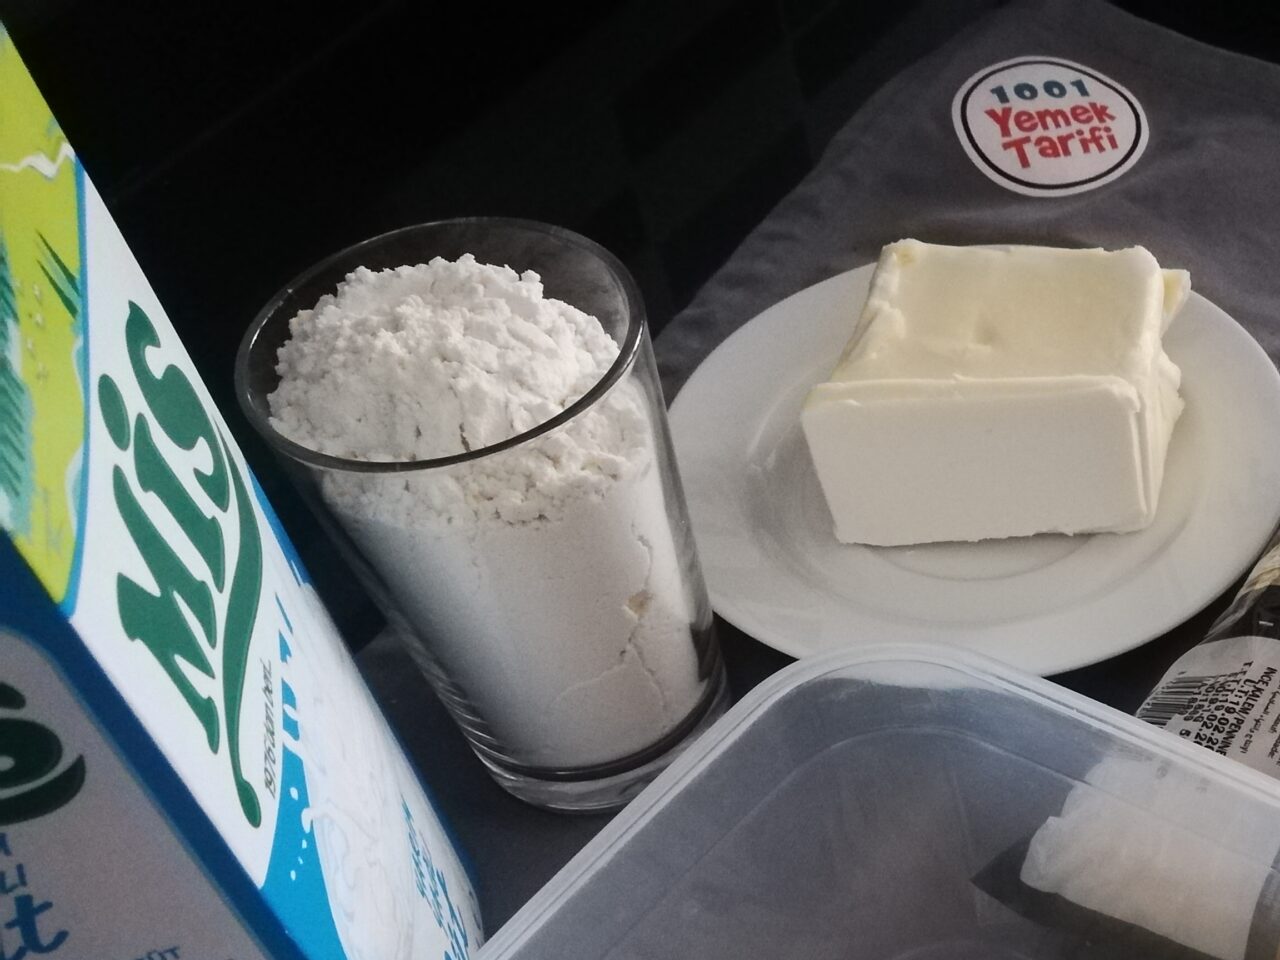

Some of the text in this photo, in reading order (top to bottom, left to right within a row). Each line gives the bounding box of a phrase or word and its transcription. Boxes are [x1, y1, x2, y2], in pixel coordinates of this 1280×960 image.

[990, 79, 1090, 104] 1001
[984, 102, 1116, 138] Yemek
[1002, 126, 1119, 169] Tarifi
